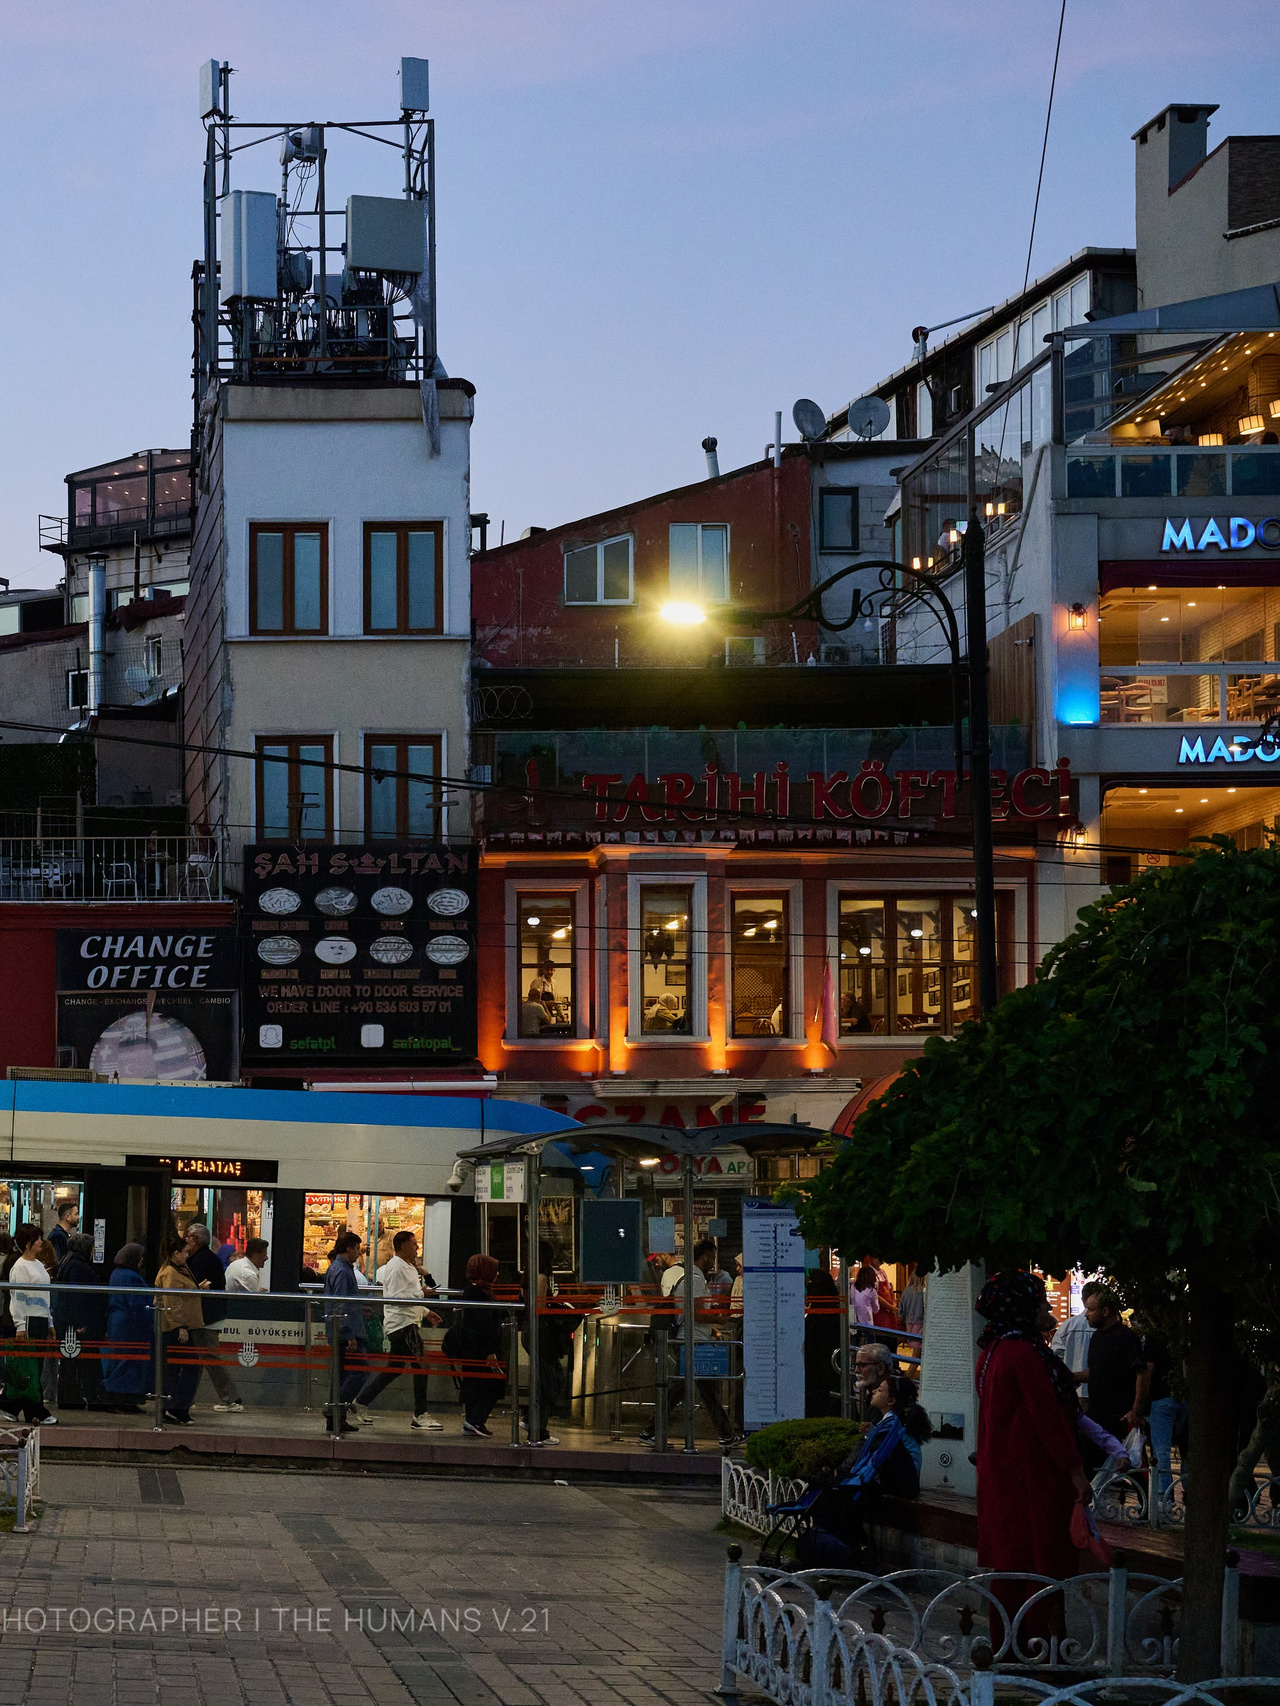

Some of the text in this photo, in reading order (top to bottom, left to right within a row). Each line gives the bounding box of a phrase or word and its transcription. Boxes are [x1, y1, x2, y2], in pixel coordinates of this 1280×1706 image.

[1160, 516, 1280, 551] MADO
[581, 760, 789, 823] TARİHİ
[79, 935, 217, 959] CHANGE
[86, 964, 211, 989] OFFICE
[258, 984, 464, 998] WE HAVE DOOR TO DOOR SERVICE
[64, 998, 98, 1006] CHANGE
[104, 997, 148, 1005] EXCHANGE
[199, 997, 231, 1005] CAMBIO
[266, 1001, 308, 1014] ORDER
[312, 1001, 341, 1014] LINE
[312, 1195, 333, 1203] WITH
[220, 1326, 305, 1338] BUL BÜYÜKŞEHİ
